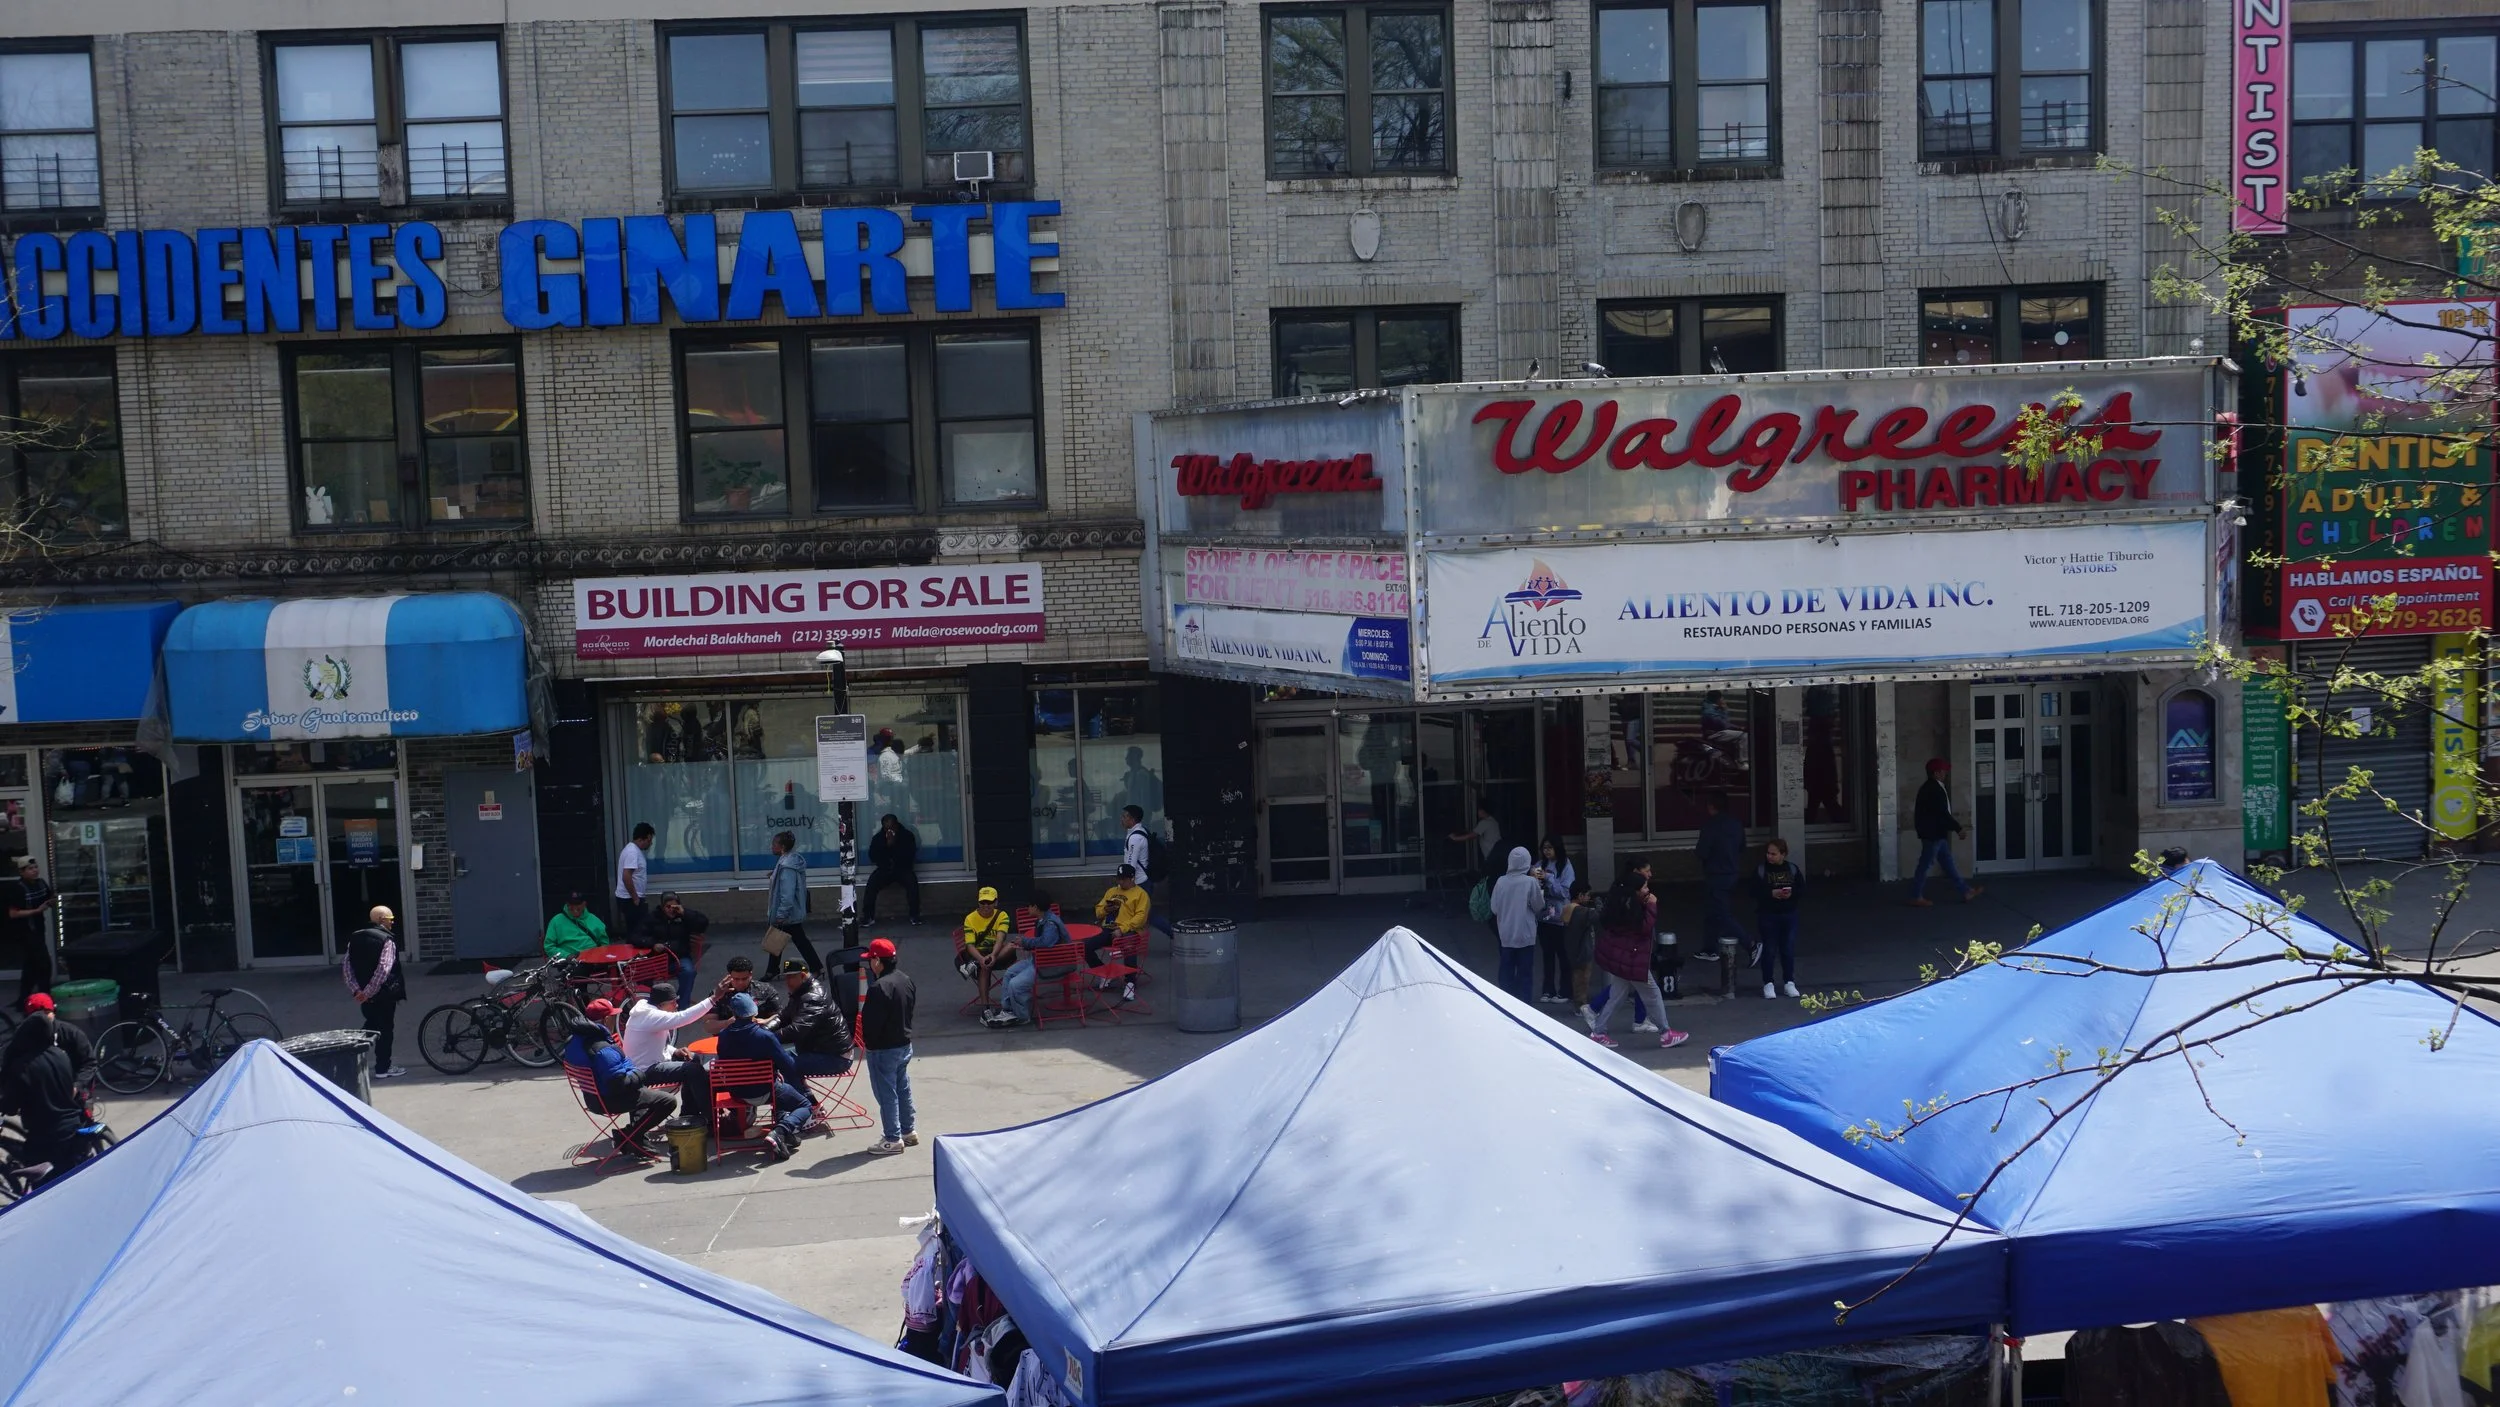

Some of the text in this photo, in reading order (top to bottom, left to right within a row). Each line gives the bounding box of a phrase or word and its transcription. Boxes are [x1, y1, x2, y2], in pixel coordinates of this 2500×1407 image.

[500, 201, 1066, 330] GINARTE
[0, 221, 448, 341] CCIDENTES
[2297, 432, 2485, 473] DENTIST
[1171, 452, 1382, 510] Walgreens
[1840, 458, 2161, 512] PHARMACY
[2300, 483, 2481, 513] ADULT &
[2296, 516, 2483, 546] CHILDREN
[1186, 550, 1242, 574] STORE
[1264, 553, 1333, 578] OFFICE
[1336, 554, 1406, 581] SPACE
[2024, 550, 2154, 566] Victor y Hattie Tiburcio
[2062, 563, 2117, 575] PASTORES
[1186, 574, 1230, 600] FOR
[2290, 564, 2483, 587] HABLAMOS ESPAÑOL
[587, 573, 1031, 621] BUILDING FOR SALE
[1617, 580, 1994, 621] ALIENTO DE VIDA INC.
[2028, 601, 2150, 617] TEL. 718-205-1209
[2329, 596, 2356, 607] Call
[1478, 596, 1587, 640] Aliento
[1683, 617, 1932, 639] RESTAURANDO PERSONAS Y FAMILIAS
[2029, 616, 2149, 628] WWW.ALIENTODEVIDA.ORG
[644, 622, 1039, 647] Mordechai Balakhaneh (212) 359-9915 Mbala@rosewoodrg.com
[1478, 640, 1502, 649] DE
[1511, 637, 1584, 657] VIDA
[1210, 639, 1332, 664] ALIENTO DE VIDA INC.
[242, 707, 420, 733] Sabor Guatemalteco
[85, 825, 97, 839] B
[766, 815, 815, 829] beauty
[1663, 976, 1675, 993] 8
